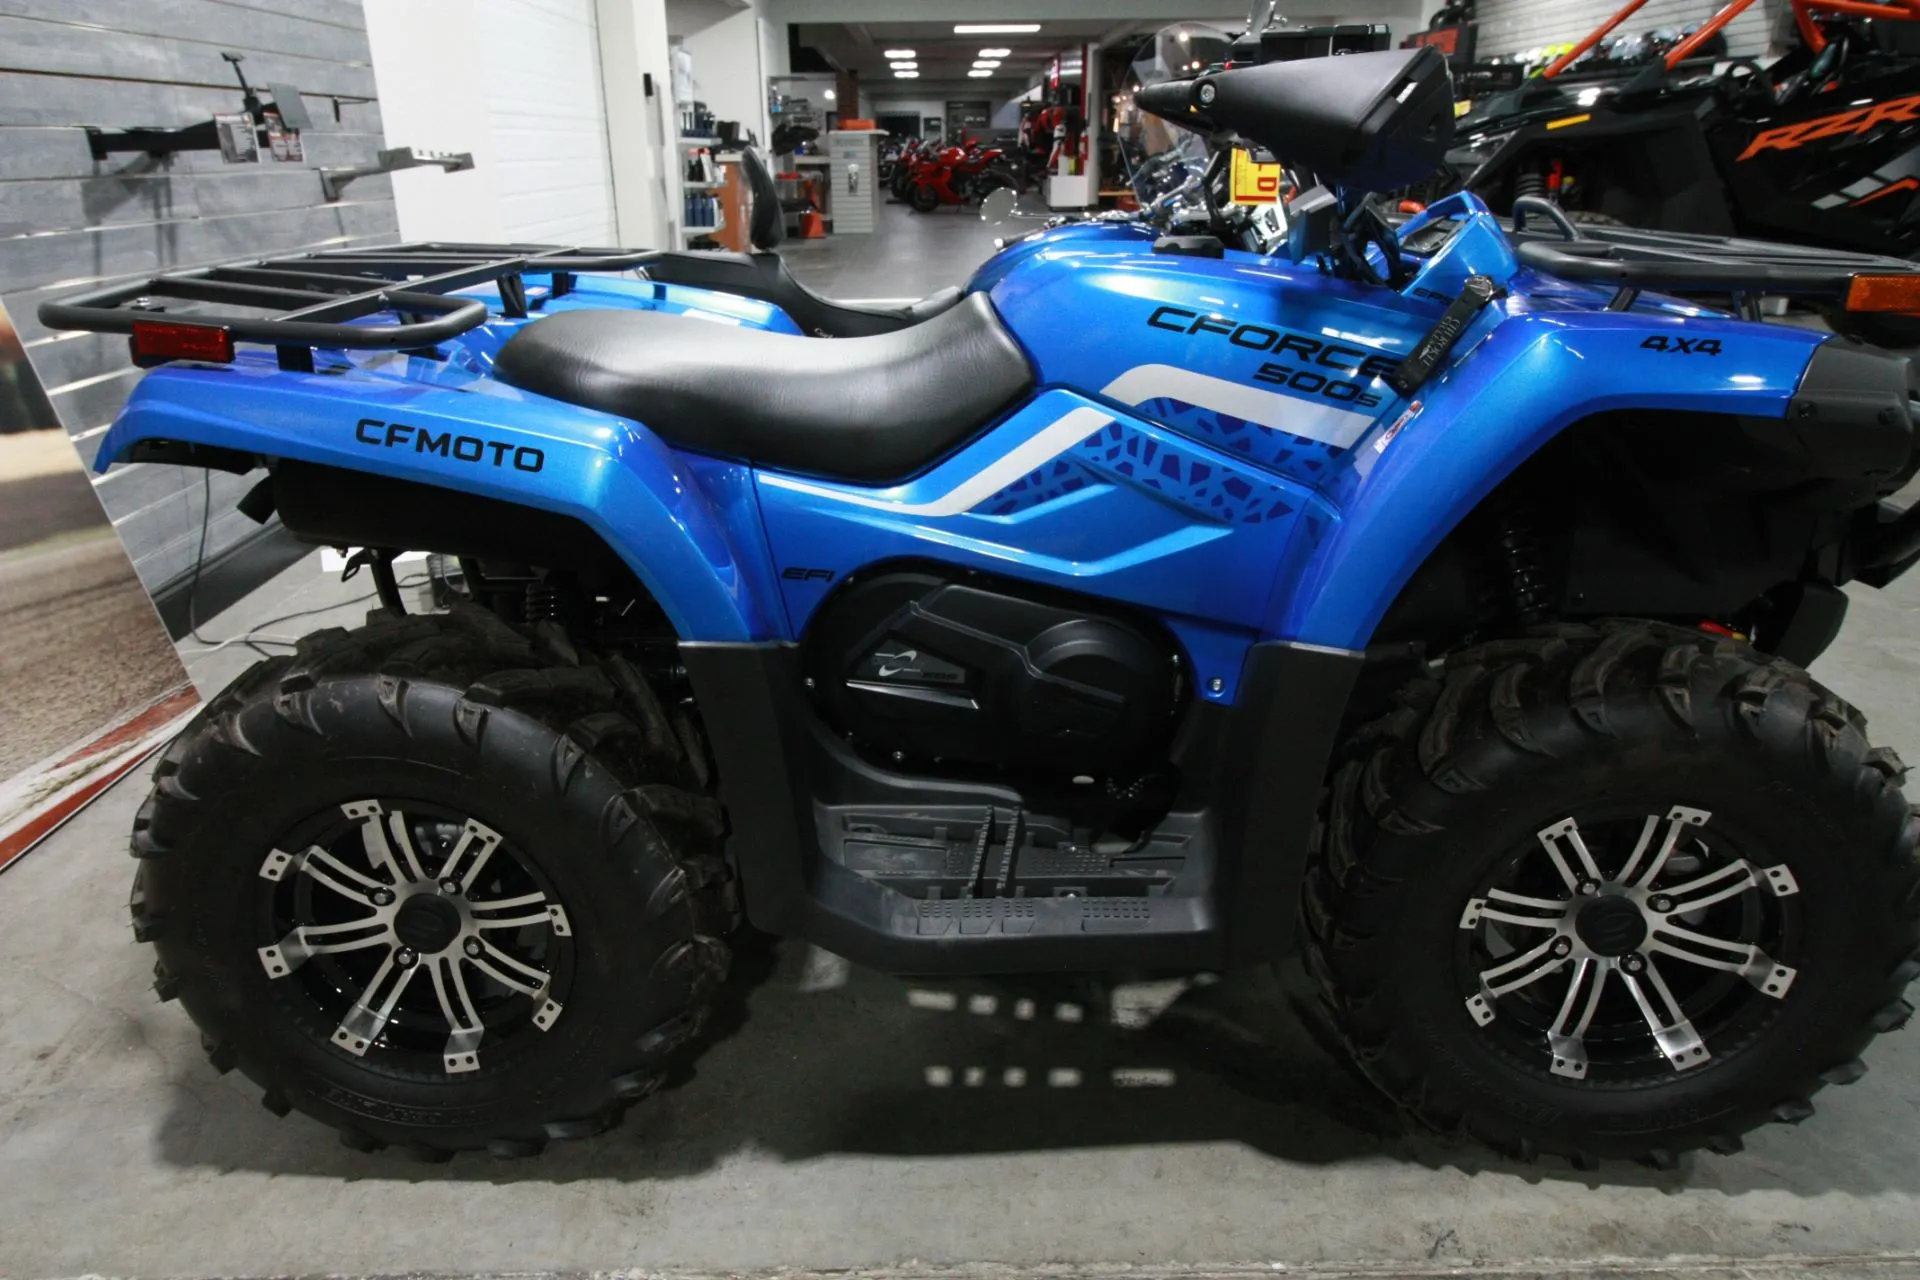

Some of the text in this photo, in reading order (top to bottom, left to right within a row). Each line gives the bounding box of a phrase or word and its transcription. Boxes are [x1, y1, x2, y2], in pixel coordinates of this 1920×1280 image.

[1735, 93, 1920, 163] RZR
[1147, 306, 1403, 383] CFORCE
[356, 418, 545, 473] CFMOTO
[782, 566, 837, 583] EFI
